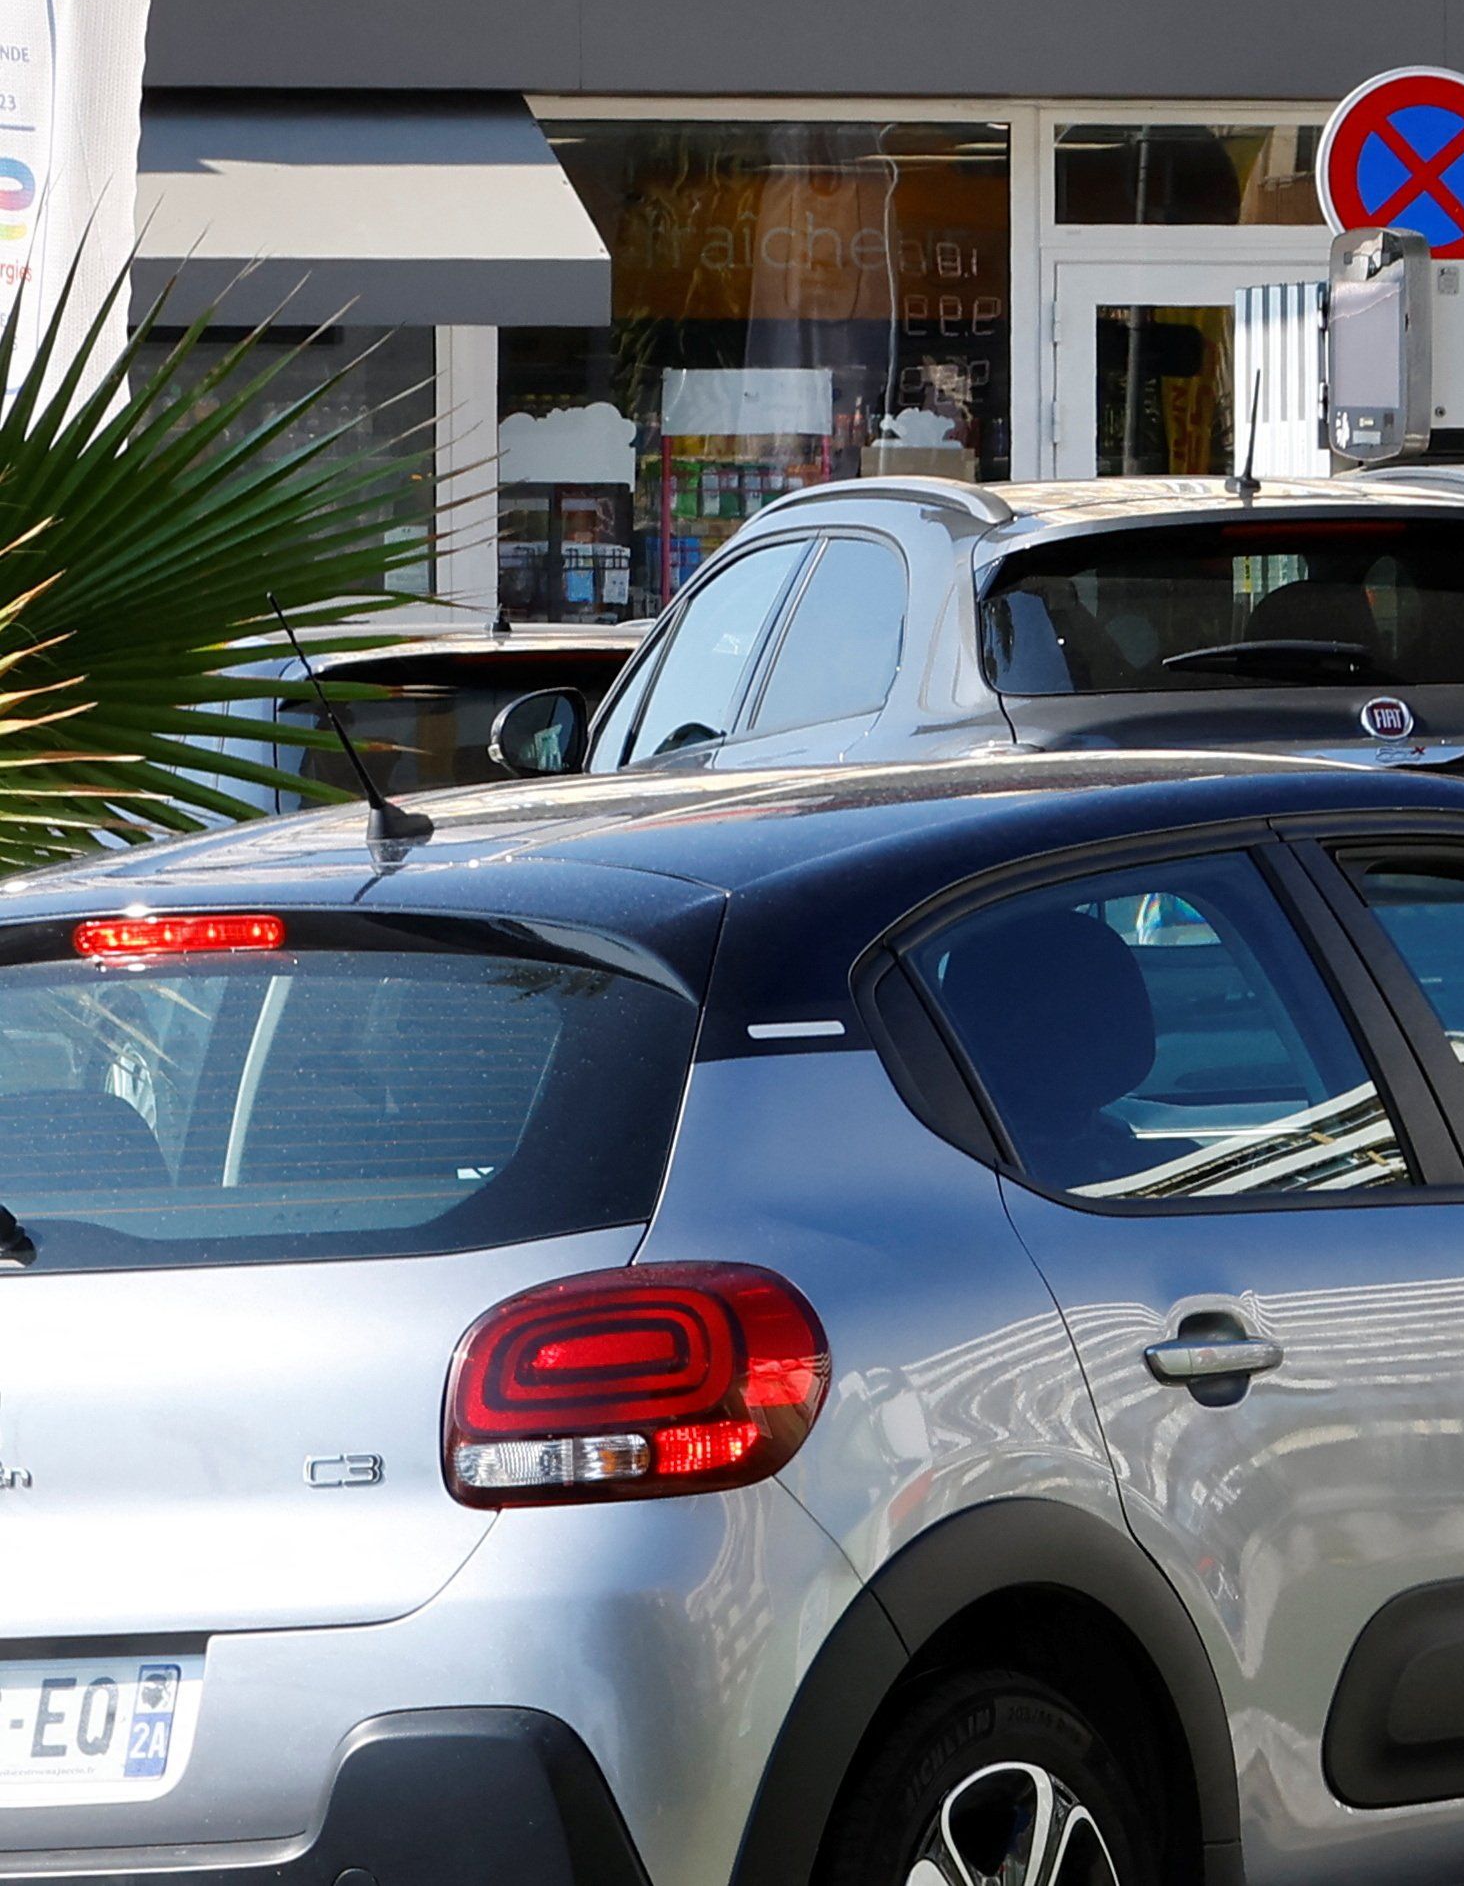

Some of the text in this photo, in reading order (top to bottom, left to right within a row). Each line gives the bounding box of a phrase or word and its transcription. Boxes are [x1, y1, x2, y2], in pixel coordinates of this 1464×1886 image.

[1373, 708, 1402, 729] FIAT
[304, 1452, 384, 1488] C3
[0, 1677, 119, 1756] -EQ
[129, 1722, 165, 1759] 2A
